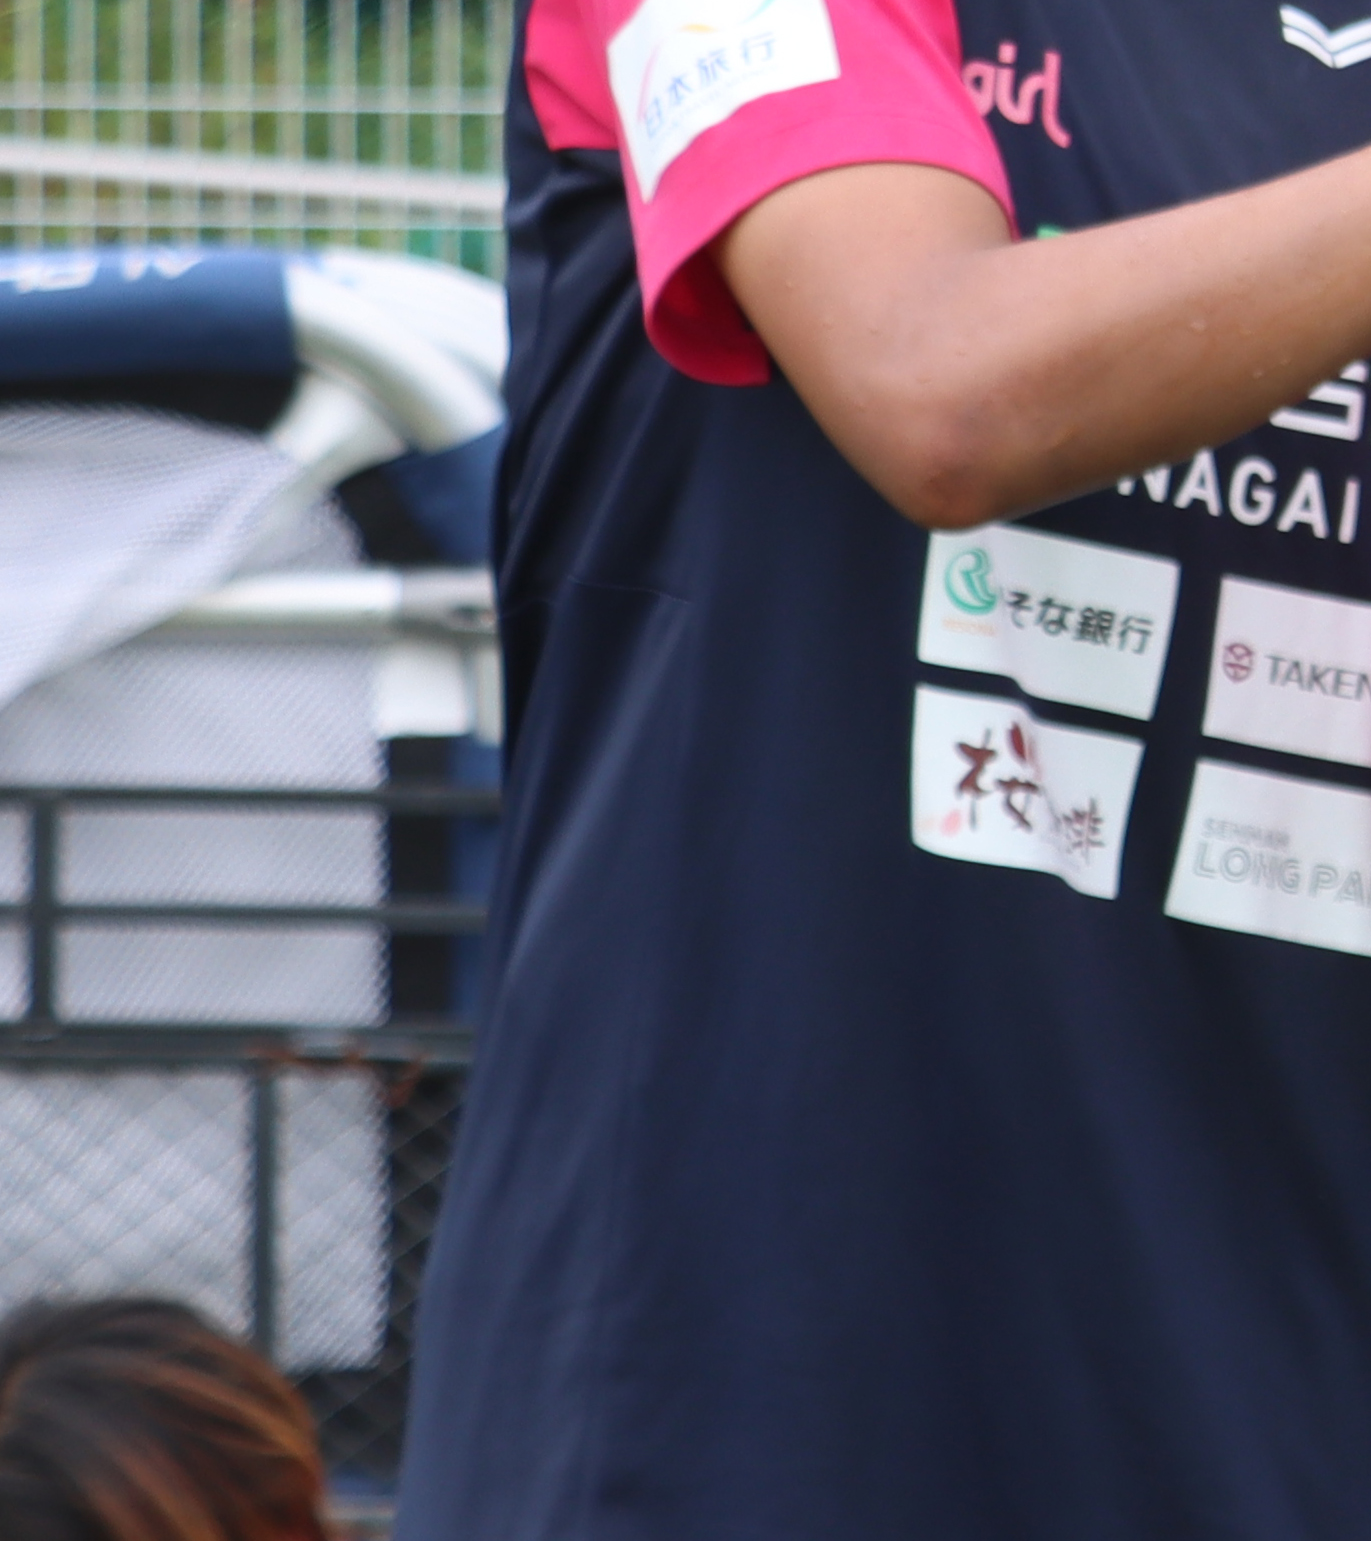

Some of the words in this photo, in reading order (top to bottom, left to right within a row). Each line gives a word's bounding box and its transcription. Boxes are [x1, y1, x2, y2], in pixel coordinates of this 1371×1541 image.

[645, 31, 776, 140] 日本旅行
[1004, 589, 1155, 656] そな銀行
